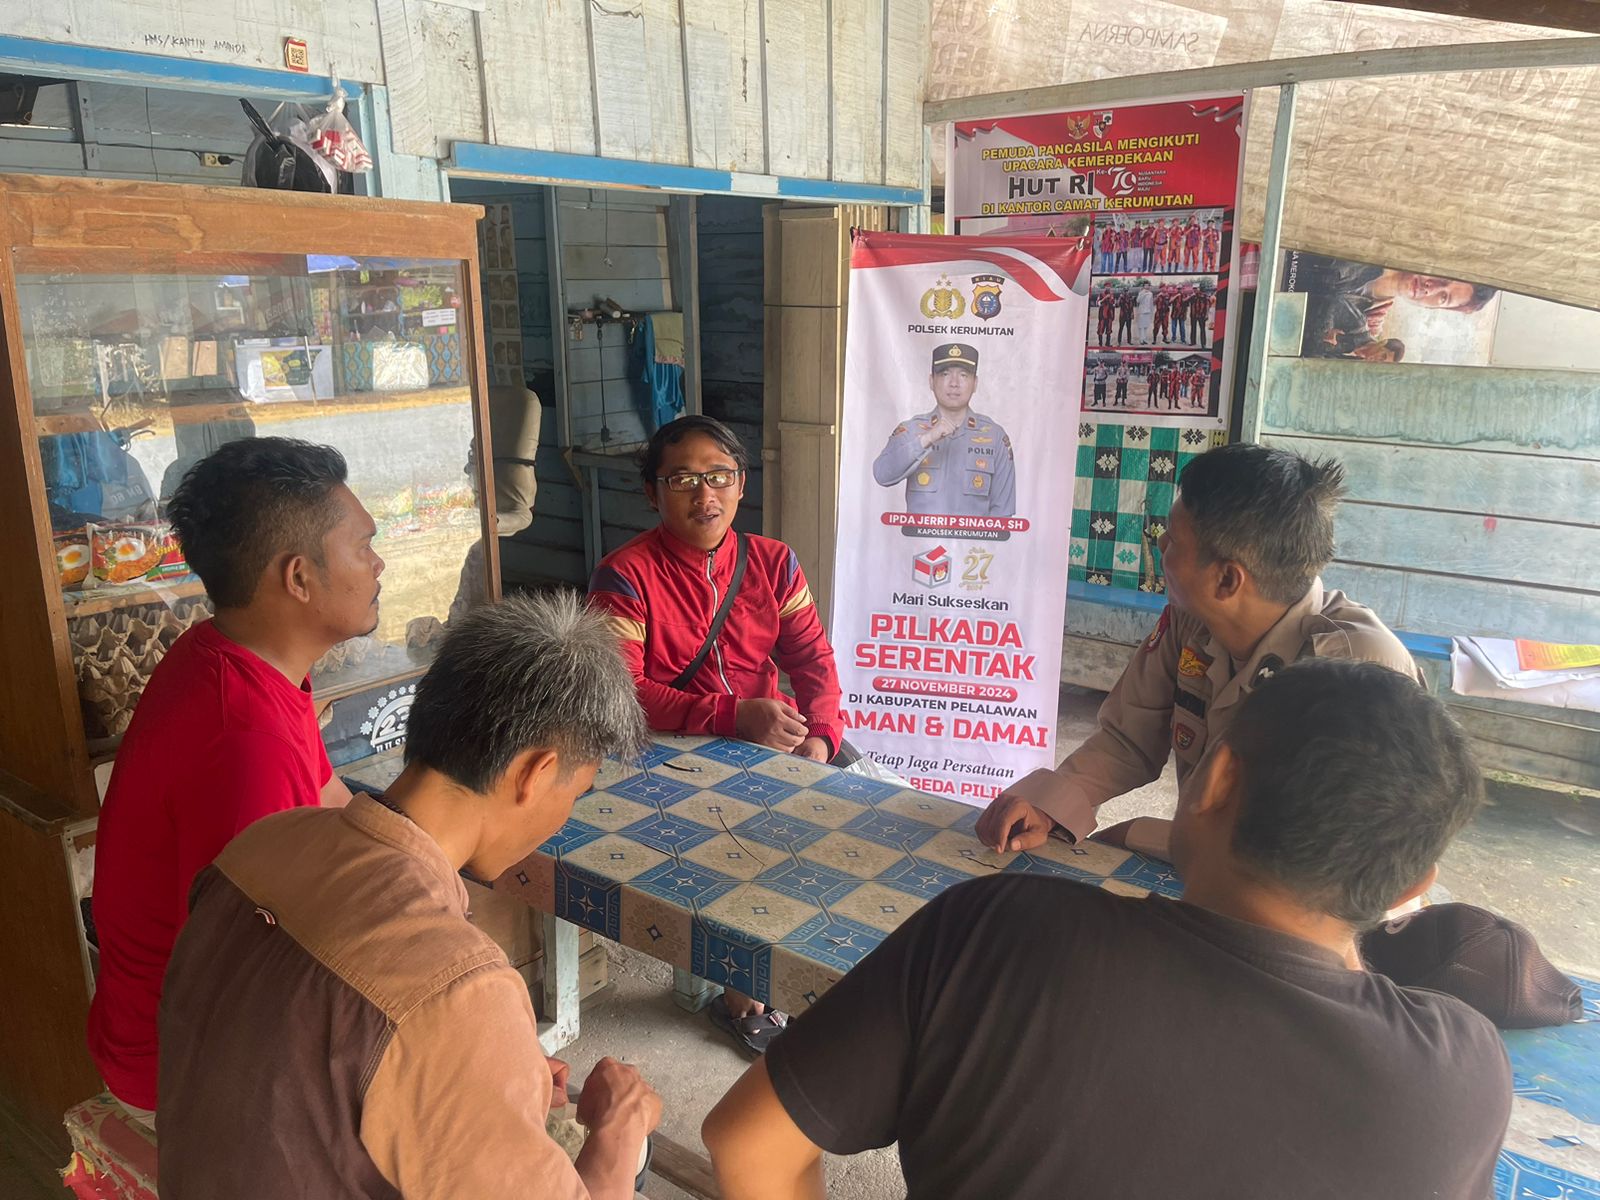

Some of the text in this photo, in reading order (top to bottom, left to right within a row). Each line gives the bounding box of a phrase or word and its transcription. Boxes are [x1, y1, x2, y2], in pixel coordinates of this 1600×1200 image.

[981, 132, 1201, 161] PEMUDA PANCASILA MENGIKUTI
[1002, 149, 1174, 173] UPACARA KEMERDEKAAN
[1007, 175, 1062, 199] HUT
[1068, 171, 1095, 197] RI
[1107, 166, 1138, 196] 79
[981, 193, 1195, 214] DI KANTOR CAMAT KERUMUTAN
[907, 324, 1014, 336] POLSEK KERUMUTAN
[889, 514, 915, 525] IPDA
[917, 515, 948, 526] JERRI
[949, 517, 957, 526] P
[1007, 519, 1023, 530] SH
[917, 528, 998, 539] KAPOLSEK KERUMUTAN
[962, 553, 994, 581] 27
[892, 592, 1009, 611] Mari Sukseskan
[870, 613, 1024, 649] PILKADA
[855, 643, 1037, 681] SERENTAK
[881, 679, 1012, 699] 27 NOVEMBER 2024
[848, 693, 1038, 719] DI KABUPATEN PELALAWAN
[925, 716, 945, 737] &
[953, 721, 1048, 748] DAMAI
[867, 751, 1015, 778] Tetap Jaga Persatuan
